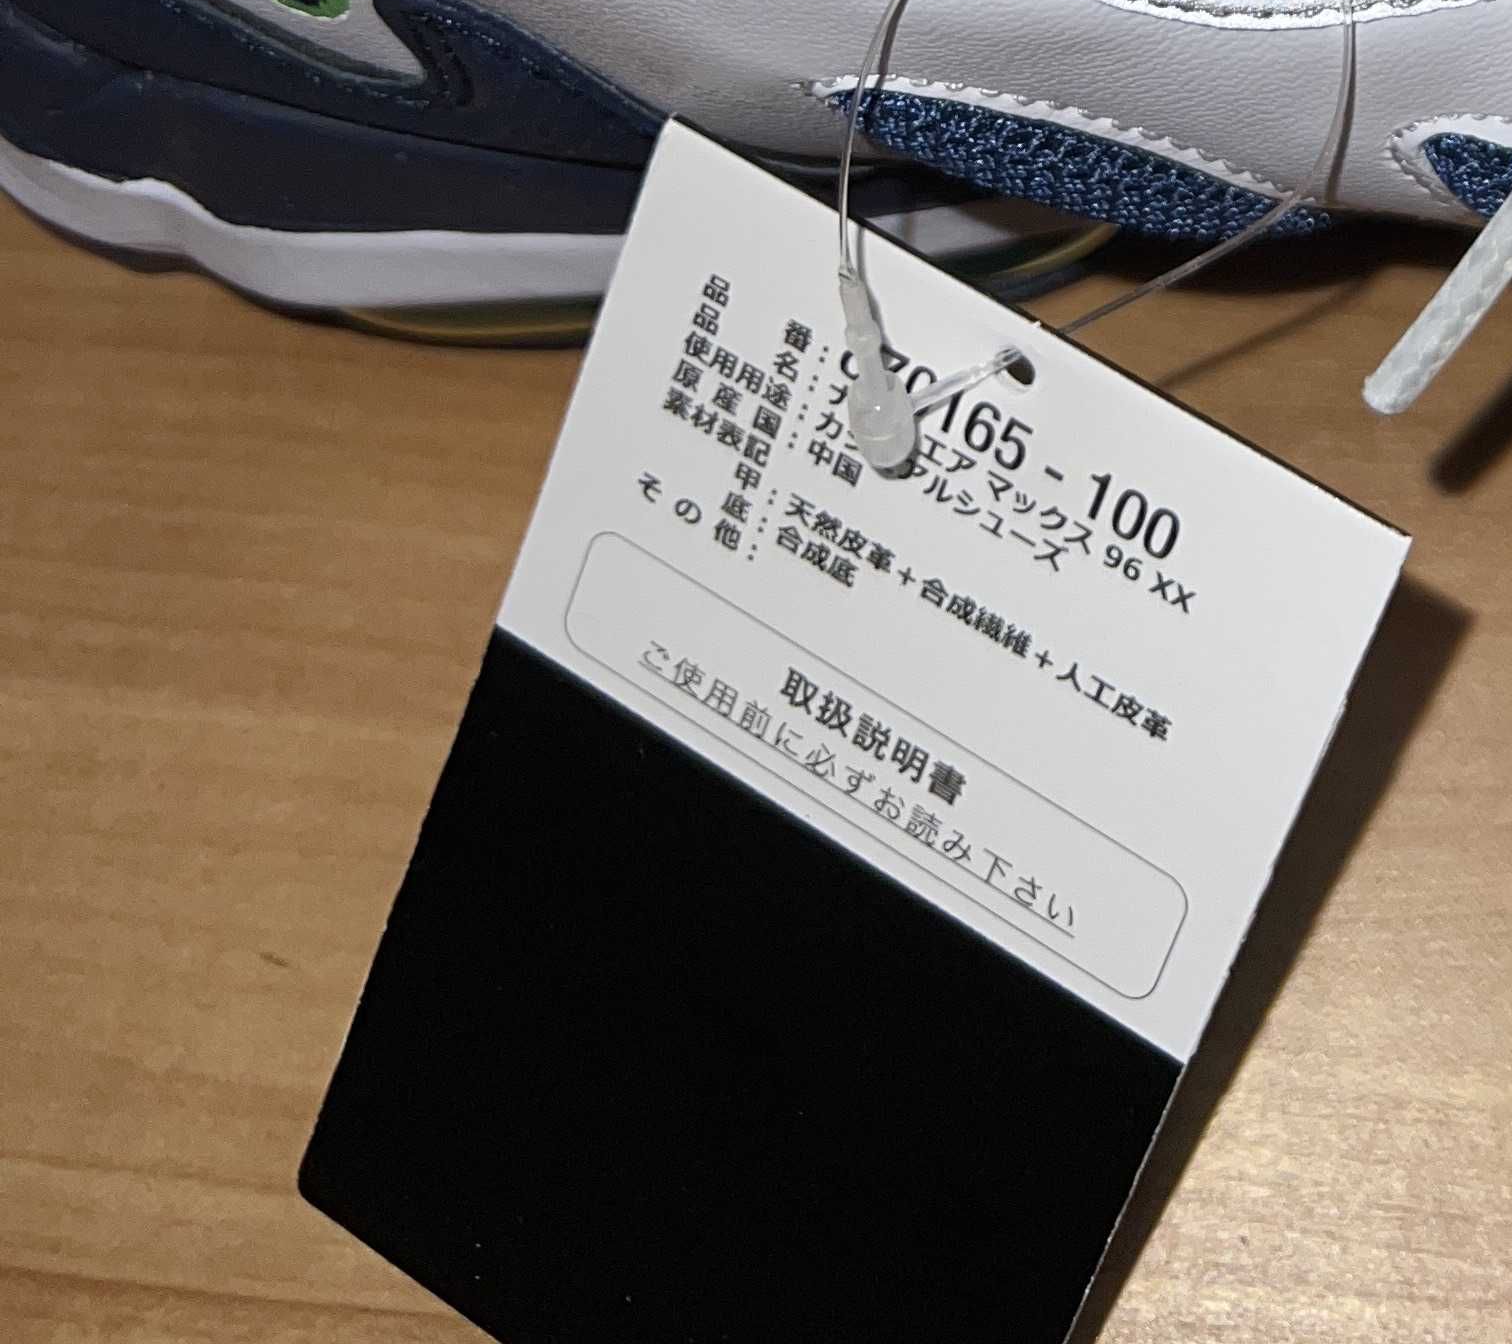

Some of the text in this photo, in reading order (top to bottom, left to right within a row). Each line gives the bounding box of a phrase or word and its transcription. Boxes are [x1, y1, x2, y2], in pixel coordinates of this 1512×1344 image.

[661, 386, 771, 468] 素材表記
[808, 438, 863, 487] 中国
[776, 524, 860, 589] 合成底
[1087, 472, 1180, 560] 100
[1102, 543, 1143, 582] 96
[1148, 570, 1196, 614] XX
[779, 665, 968, 806] 取扱説明書
[637, 640, 1075, 928] ご使用前に必ずお読み下さい
